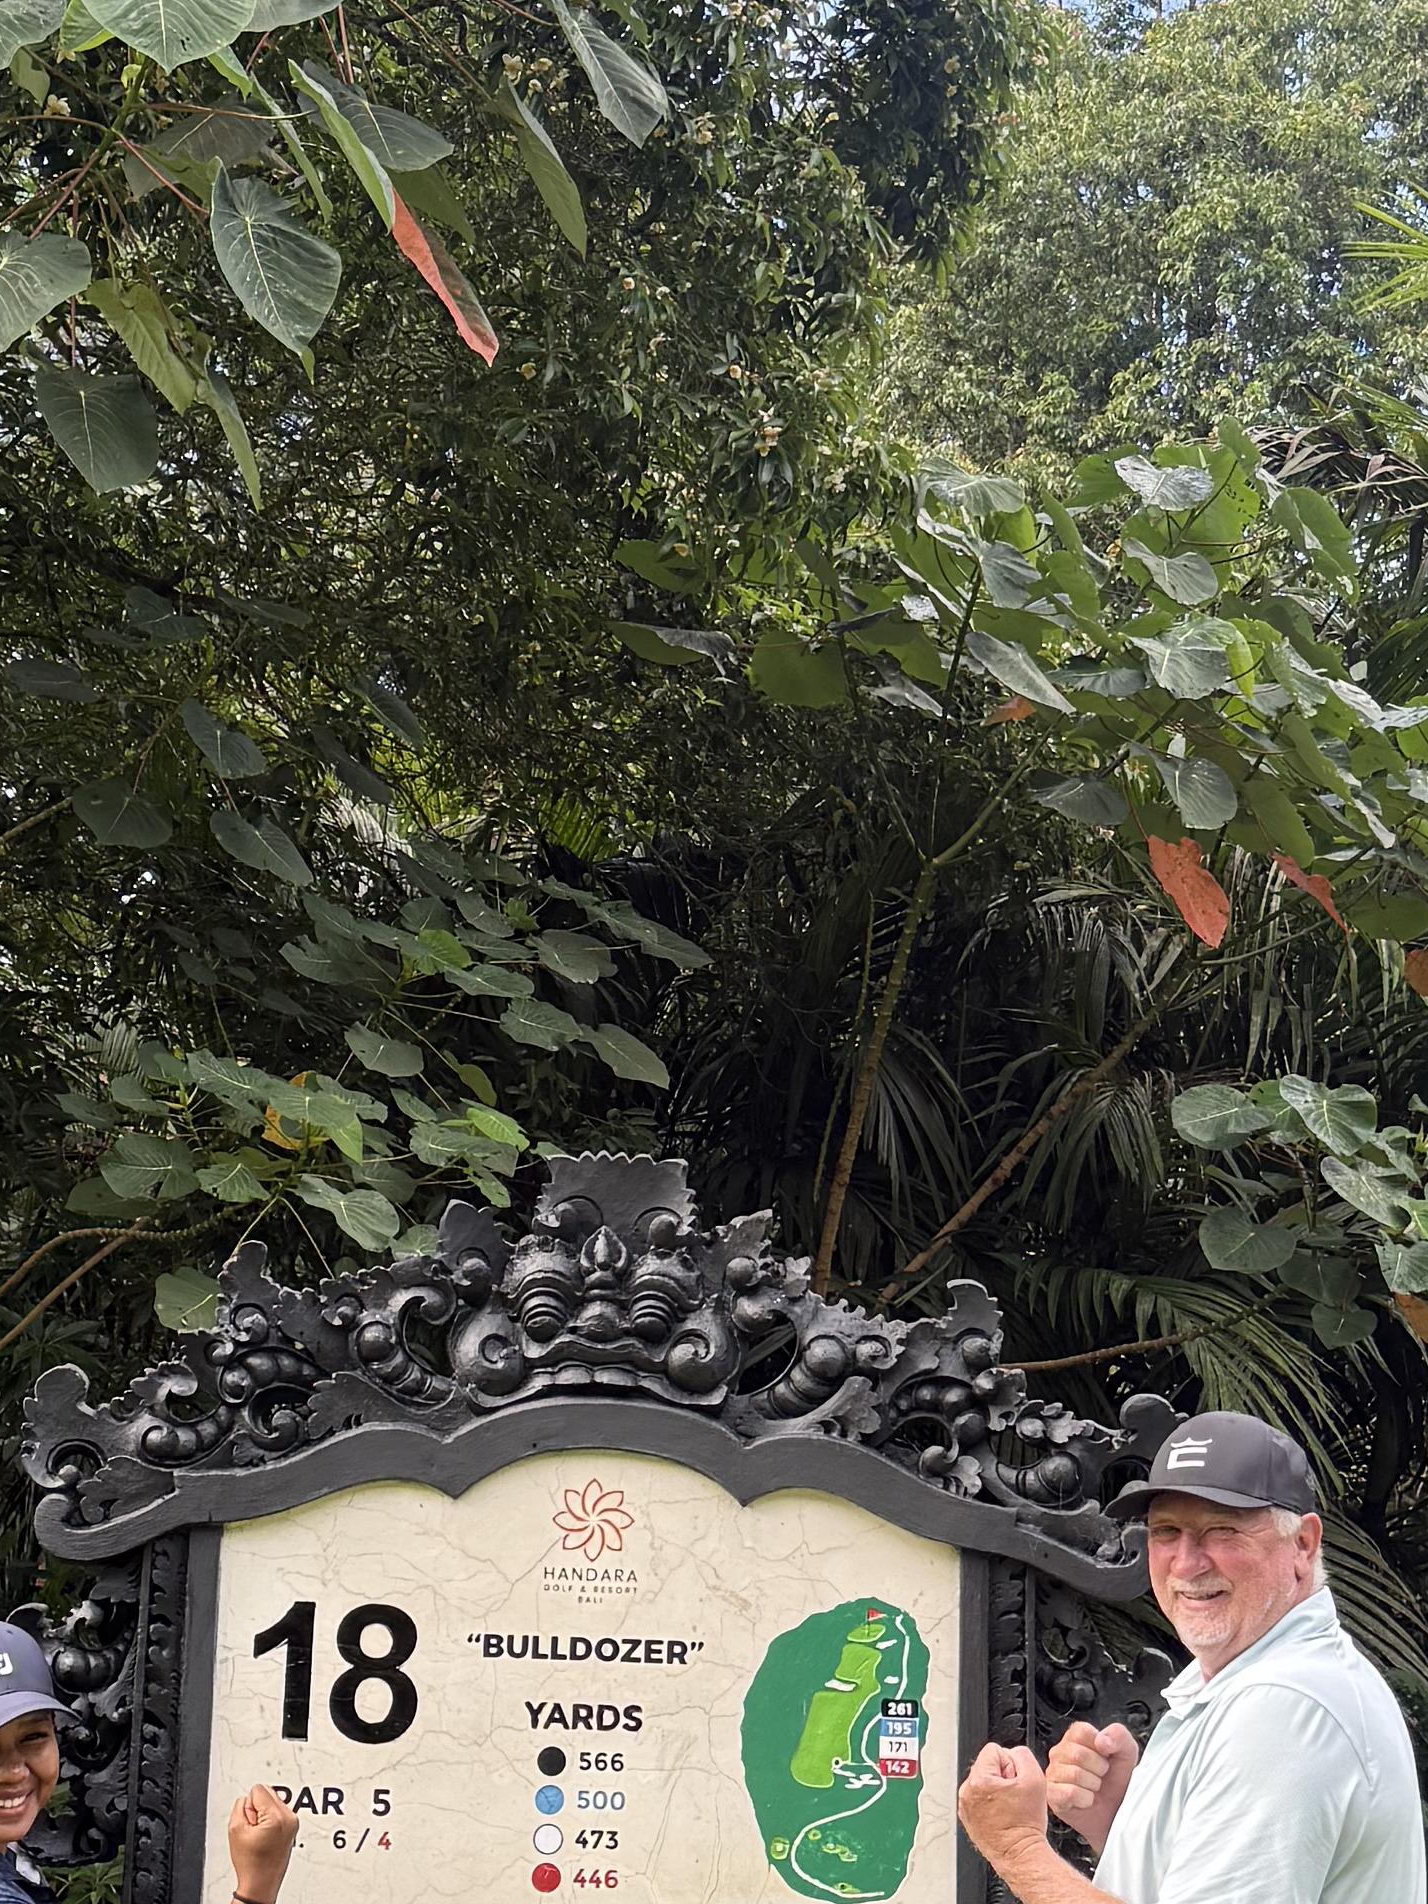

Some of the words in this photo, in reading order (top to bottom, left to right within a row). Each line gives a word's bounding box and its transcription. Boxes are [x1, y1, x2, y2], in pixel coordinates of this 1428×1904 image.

[544, 1567, 637, 1582] HANDARA
[544, 1584, 572, 1592] GOLF
[593, 1586, 637, 1594] RESORT
[467, 1633, 704, 1664] “BULLDOZER”
[253, 1601, 418, 1744] 18
[524, 1701, 643, 1732] YARDS
[887, 1702, 912, 1716] 261
[886, 1722, 912, 1735] 195
[888, 1741, 907, 1753] 171
[579, 1752, 624, 1772] 566
[886, 1760, 910, 1774] 142
[372, 1789, 391, 1816] 5
[577, 1790, 625, 1810] 500
[575, 1829, 619, 1850] 473
[573, 1868, 618, 1889] 446
